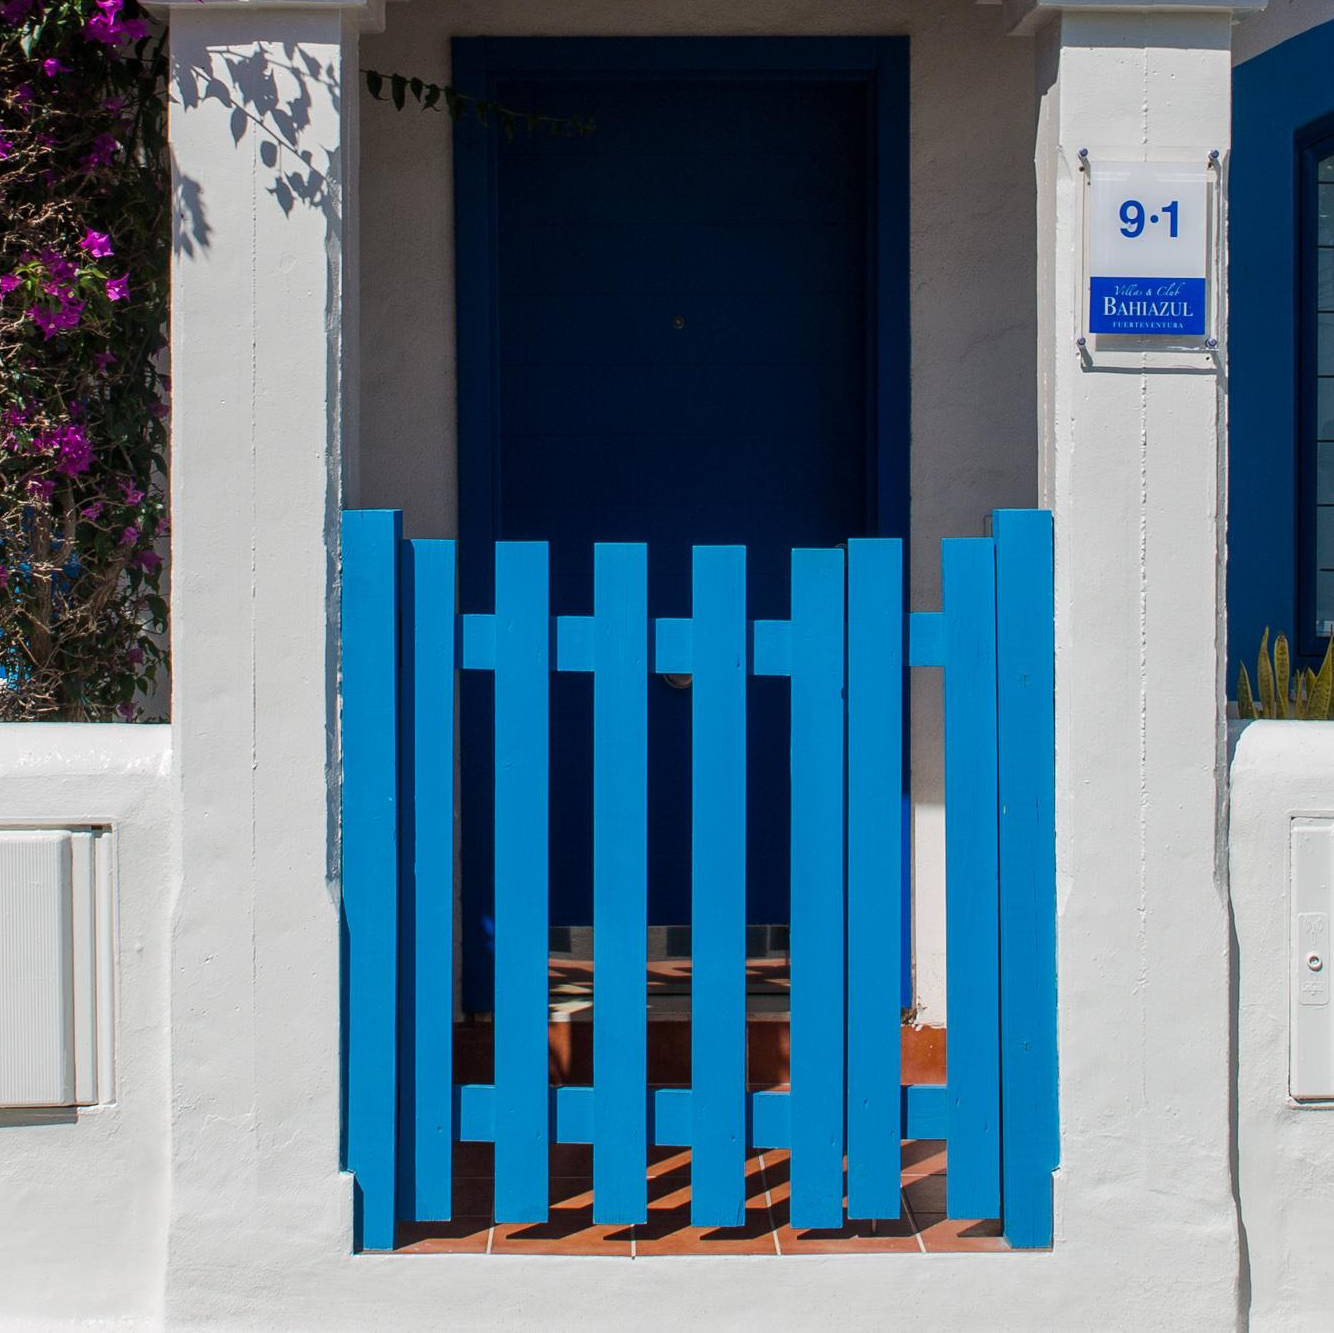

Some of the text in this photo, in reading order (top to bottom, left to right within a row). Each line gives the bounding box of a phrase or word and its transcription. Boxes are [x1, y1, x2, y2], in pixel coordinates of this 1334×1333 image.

[1145, 288, 1153, 297] &
[1103, 296, 1194, 317] BAHIAZUL
[1113, 321, 1184, 329] FUERTEVENTURA
